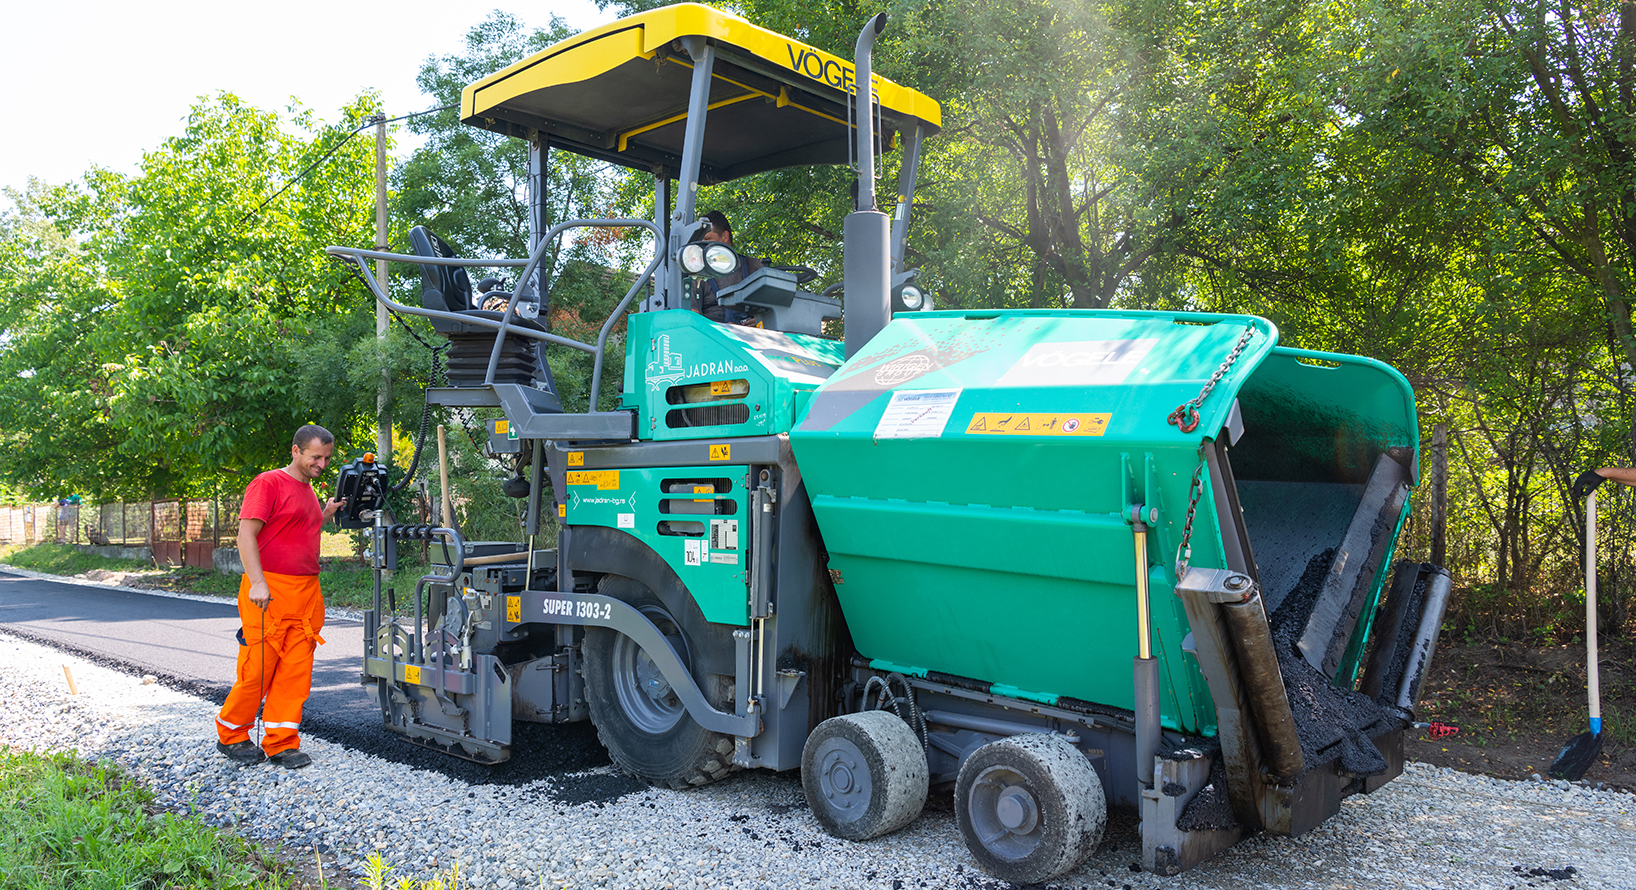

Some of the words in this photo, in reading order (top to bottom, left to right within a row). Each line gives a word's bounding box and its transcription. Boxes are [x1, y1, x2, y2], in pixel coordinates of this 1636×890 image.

[787, 43, 878, 102] VÖGEE
[1022, 351, 1149, 367] VÖGELE
[686, 360, 733, 378] JADRAN
[582, 497, 626, 505] www.jadran-bg.rs
[543, 599, 573, 616] SUPER
[576, 601, 611, 620] 1303-2
